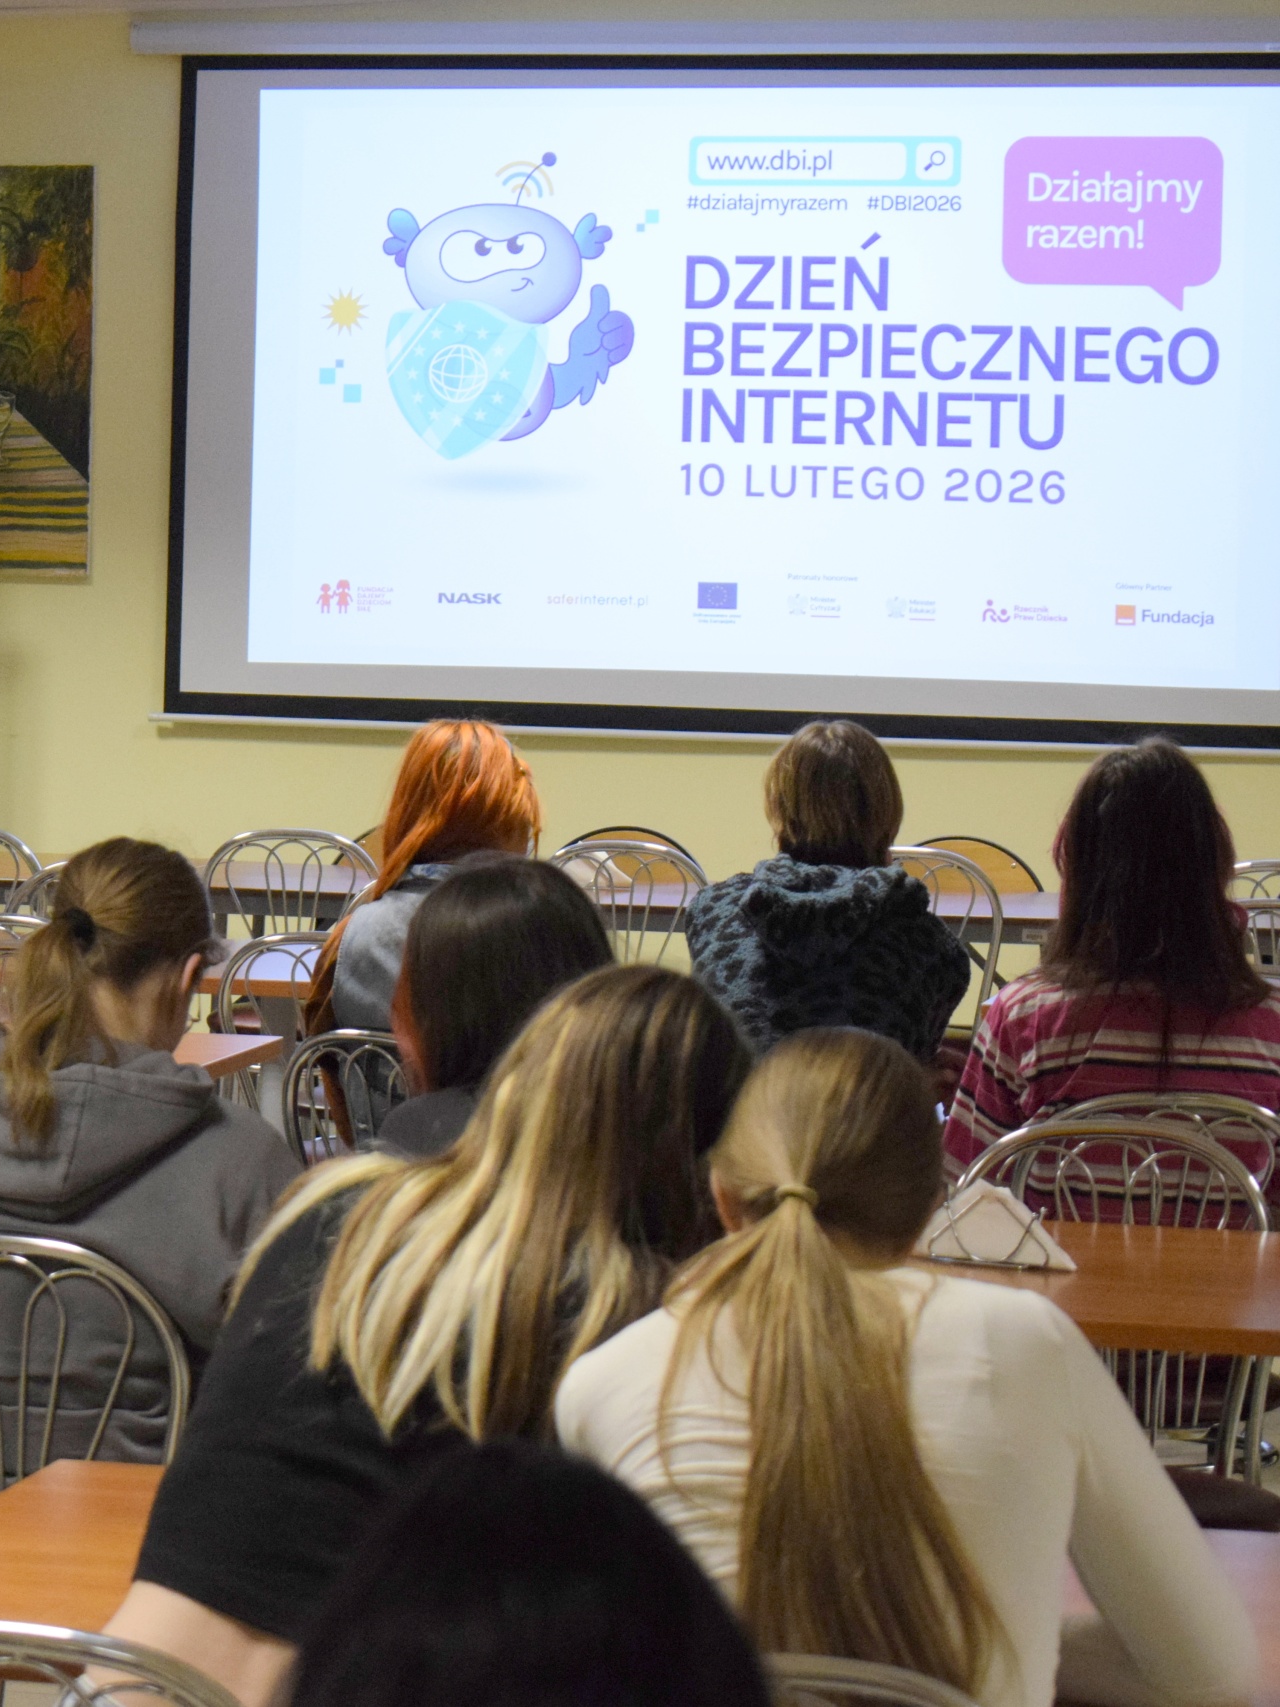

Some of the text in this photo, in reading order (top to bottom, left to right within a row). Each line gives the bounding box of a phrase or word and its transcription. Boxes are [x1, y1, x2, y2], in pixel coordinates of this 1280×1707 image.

[706, 149, 833, 178] www.dbi.pl
[686, 193, 962, 216] #działajmyrazem #DBI2026
[1027, 169, 1204, 213] Działajmy
[1026, 218, 1145, 250] razem!
[684, 231, 890, 312] DZIEŃ
[683, 321, 1220, 386] BEZPIECZNEGO
[681, 387, 1065, 451] INTERNETU
[680, 462, 1066, 505] 10 LUTEGO 2026
[437, 592, 502, 605] NASK
[546, 593, 650, 609] saferinternet.pl
[1141, 608, 1215, 628] Fundacja
